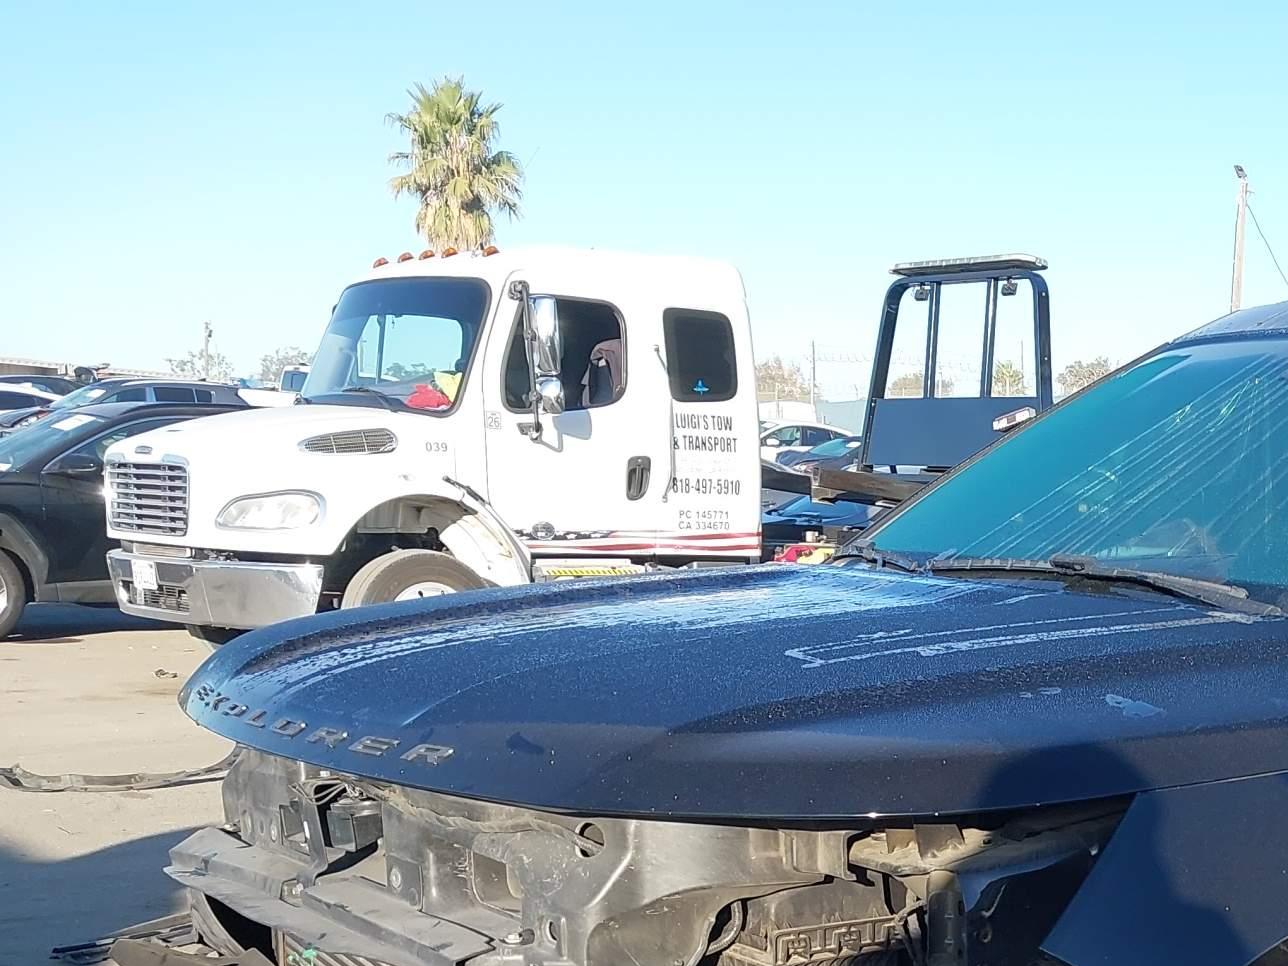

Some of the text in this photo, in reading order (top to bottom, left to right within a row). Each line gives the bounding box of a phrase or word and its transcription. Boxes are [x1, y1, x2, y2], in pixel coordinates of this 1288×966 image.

[675, 412, 733, 432] LUIGI'S TOW
[425, 441, 448, 452] 039
[683, 435, 738, 453] TRANSPORT
[672, 476, 741, 496] 818-497-5910
[679, 510, 730, 520] PC 145771
[678, 521, 730, 530] CA 334670
[195, 681, 455, 766] EXPLORER
